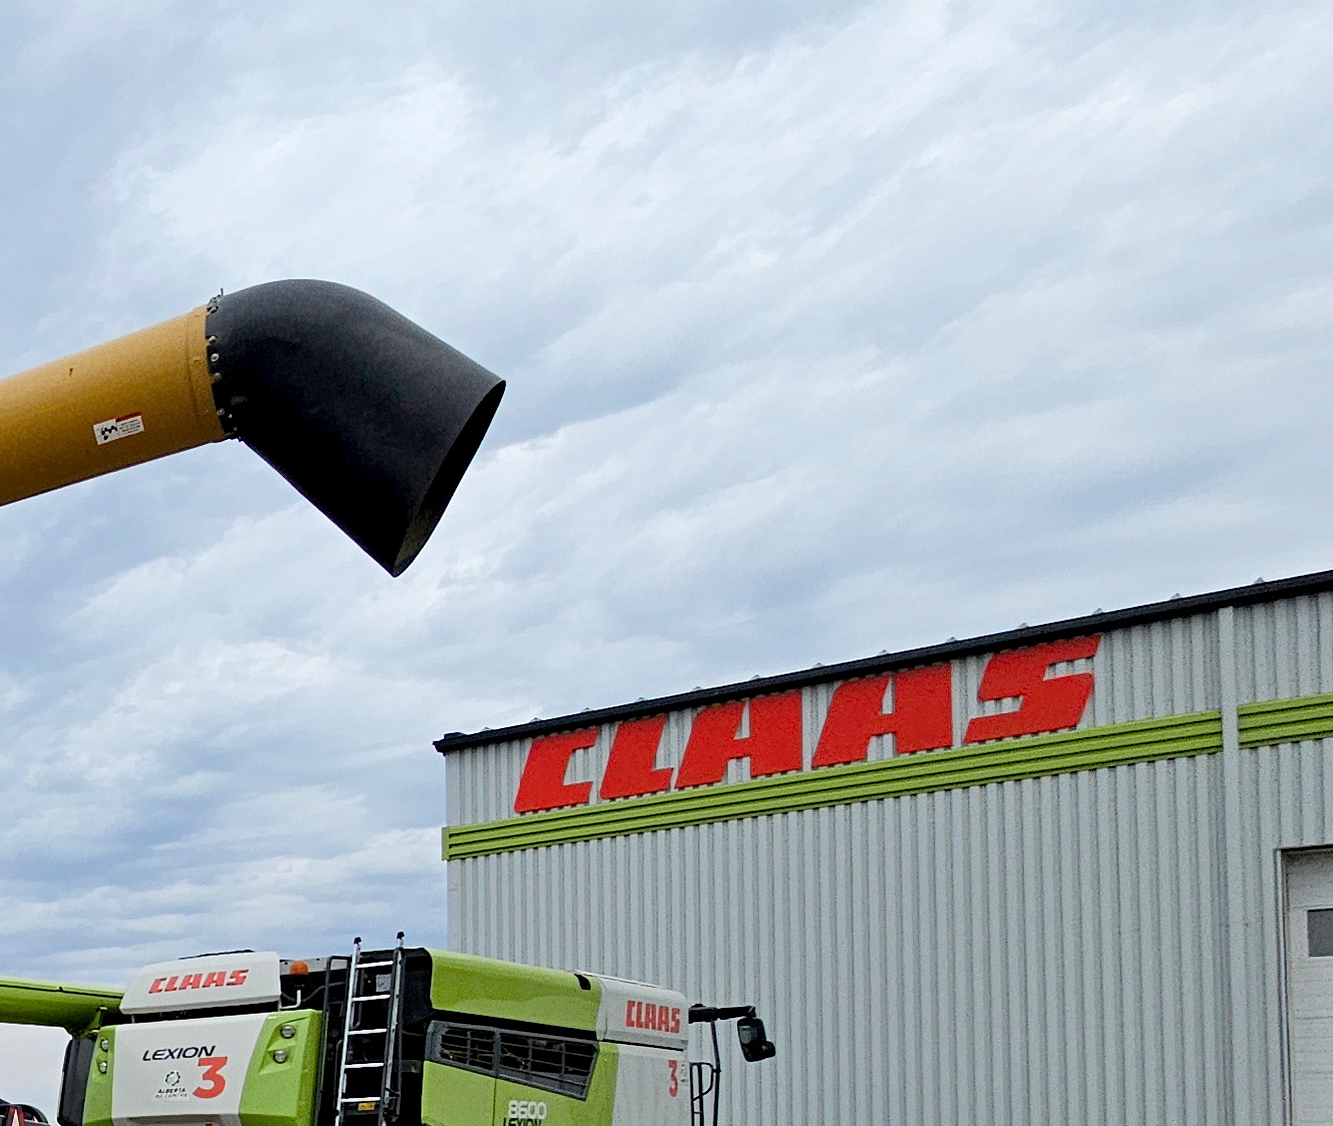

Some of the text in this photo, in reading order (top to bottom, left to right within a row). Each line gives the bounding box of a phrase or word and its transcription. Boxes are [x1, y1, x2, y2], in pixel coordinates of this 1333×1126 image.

[514, 634, 1101, 813] CLAAS
[148, 969, 249, 994] CLAAS
[626, 1000, 681, 1034] CLAAS
[142, 1045, 216, 1061] LEXION
[192, 1056, 228, 1099] 3
[667, 1059, 678, 1097] 3
[508, 1100, 548, 1119] 8600
